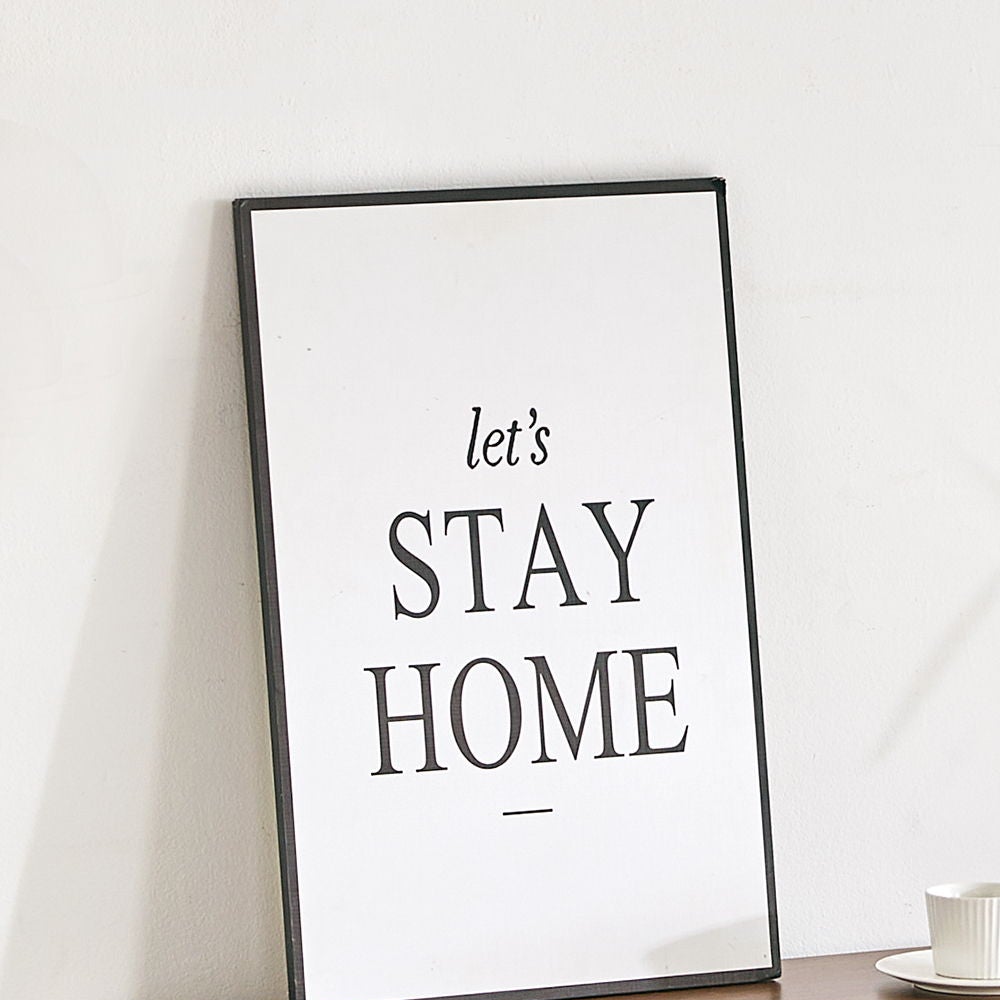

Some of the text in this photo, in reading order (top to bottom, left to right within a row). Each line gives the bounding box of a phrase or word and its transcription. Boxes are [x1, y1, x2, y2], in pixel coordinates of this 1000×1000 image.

[466, 406, 551, 470] let's
[388, 499, 655, 620] STAY
[363, 647, 689, 777] HOME
